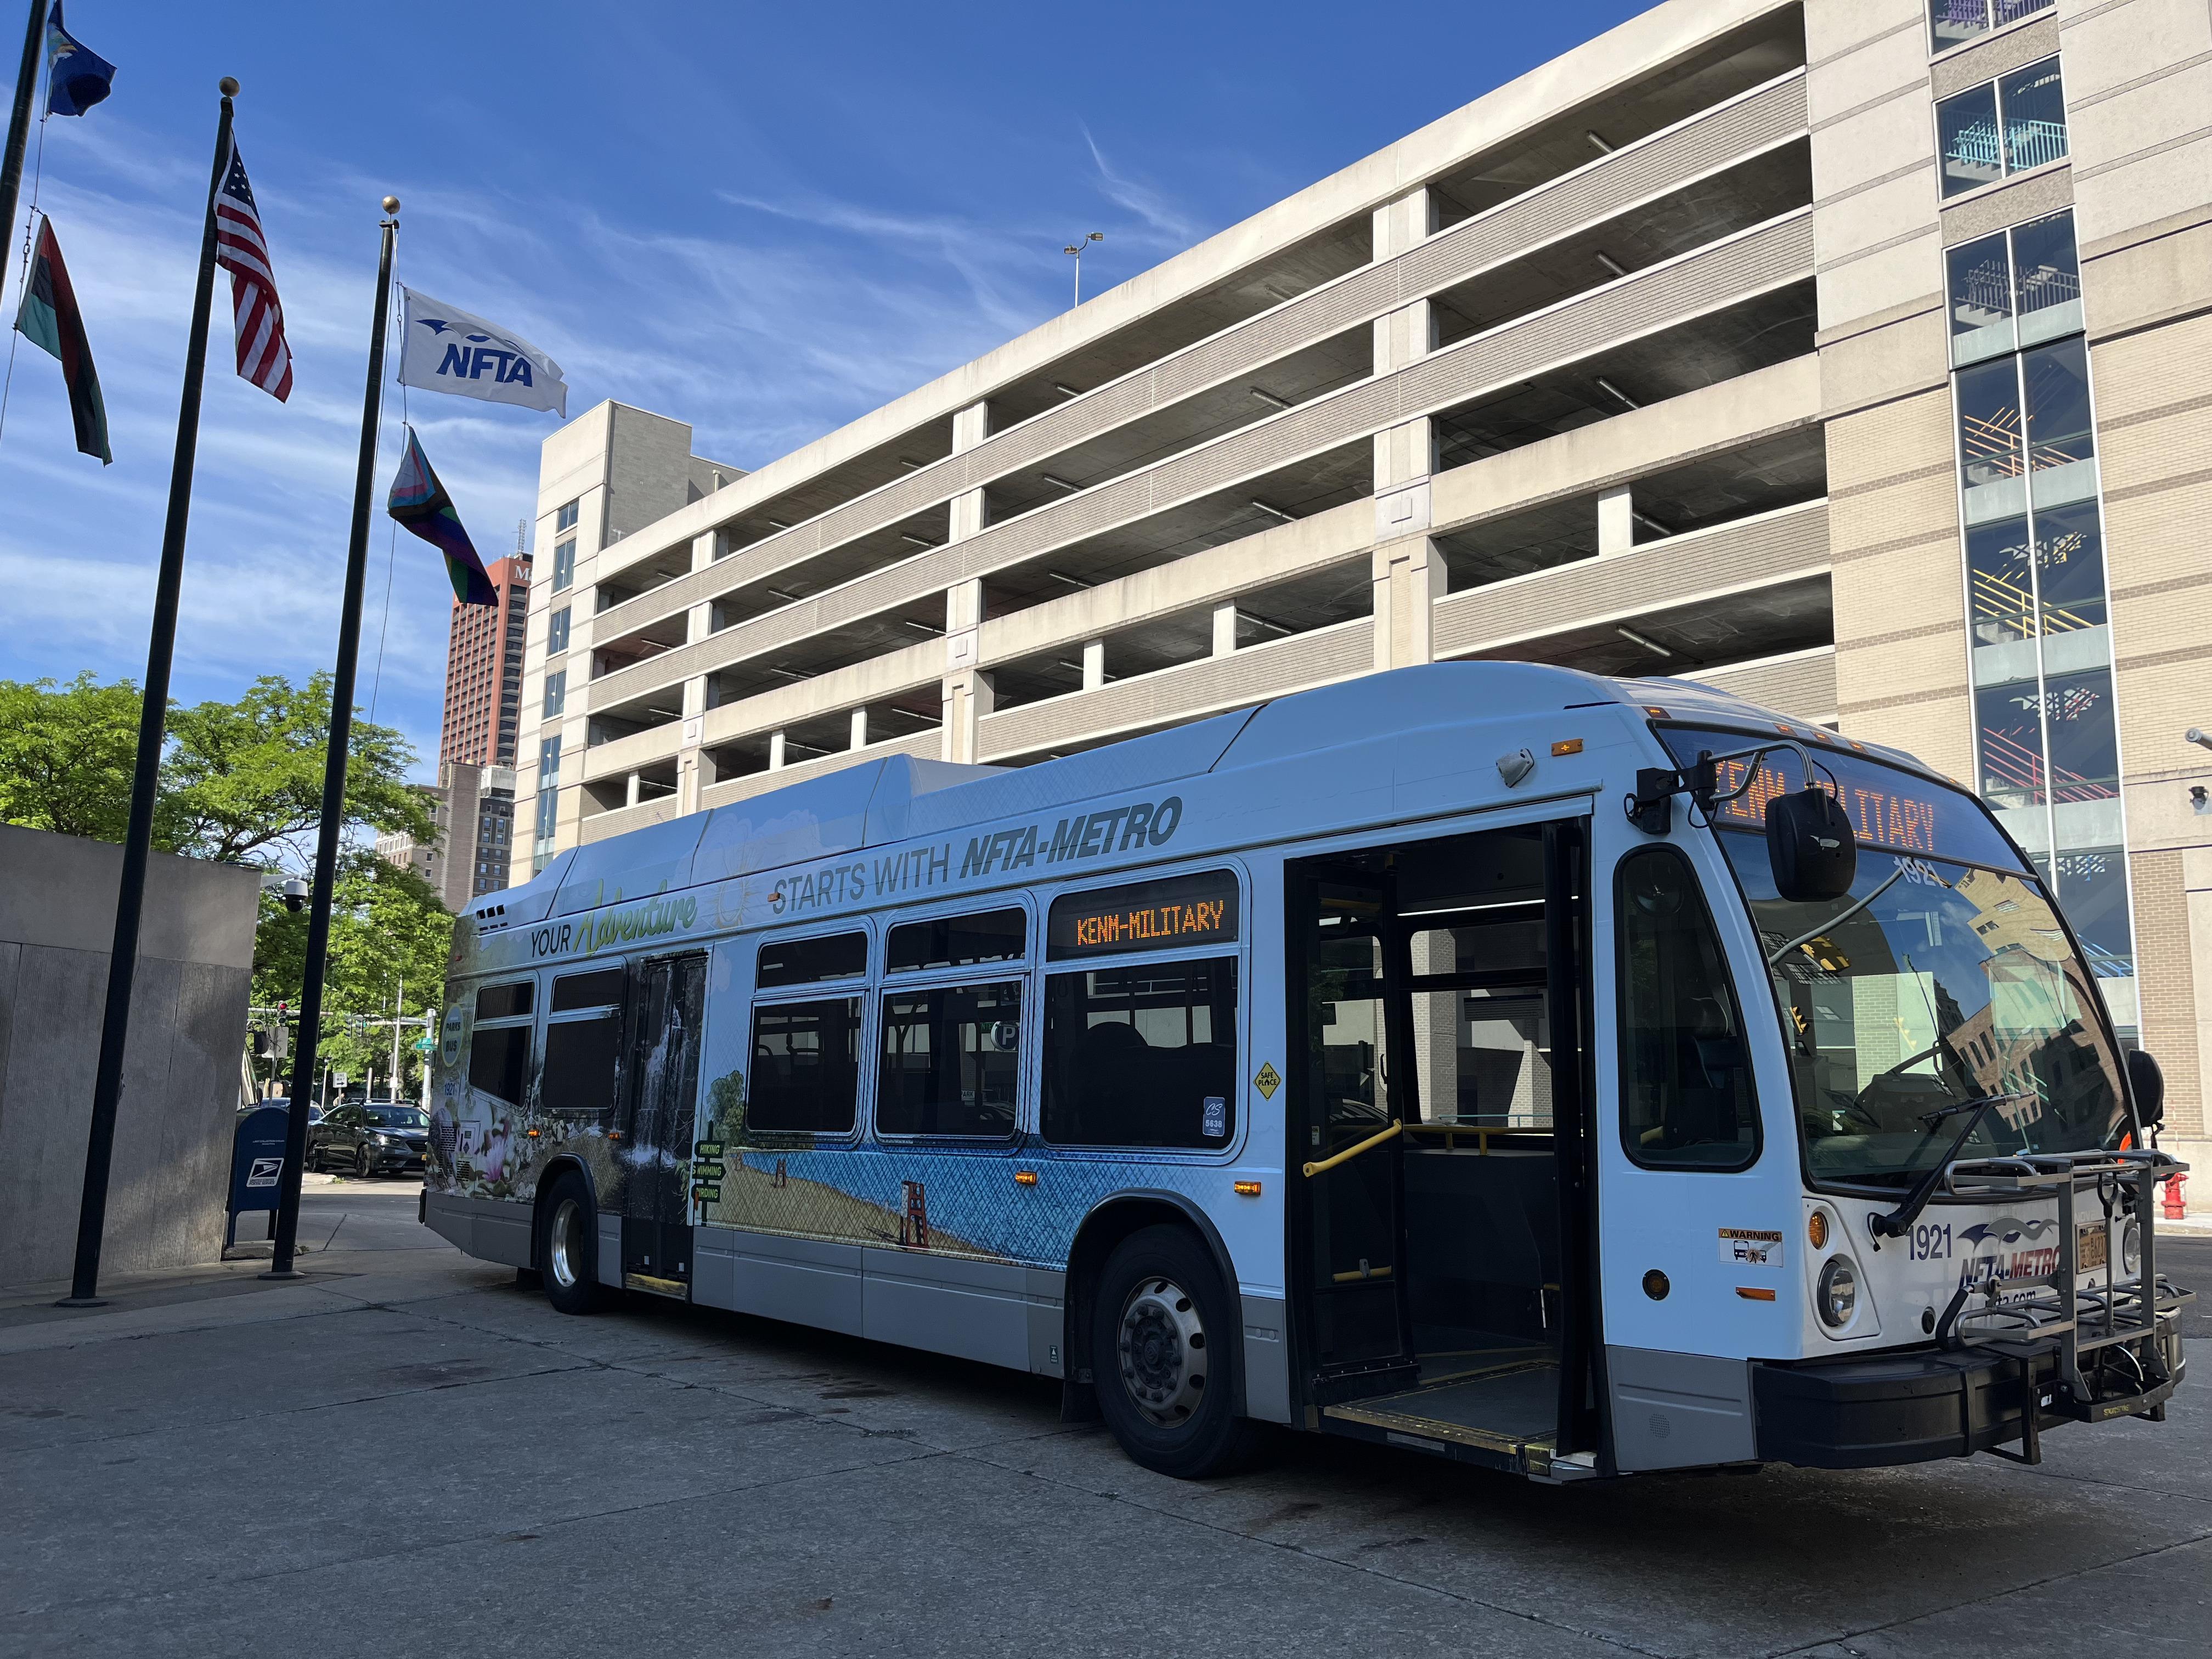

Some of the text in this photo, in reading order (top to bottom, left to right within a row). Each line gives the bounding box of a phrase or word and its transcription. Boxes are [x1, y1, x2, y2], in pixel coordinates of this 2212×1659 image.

[436, 343, 533, 387] NFTA
[531, 796, 1183, 958] YOUR Adventure STARTS WITH NFTA-METRO
[1893, 856, 1944, 888] 1921
[1077, 900, 1224, 945] KENM-MILITARY
[1002, 1026, 1015, 1045] P
[445, 1040, 458, 1052] BUS
[444, 1082, 455, 1096] 1921
[1206, 1103, 1223, 1116] CS
[1205, 1120, 1222, 1128] 5638
[699, 1144, 720, 1155] HIKING
[1730, 1230, 1779, 1241] WARNING
[1906, 1223, 1951, 1260] 1921
